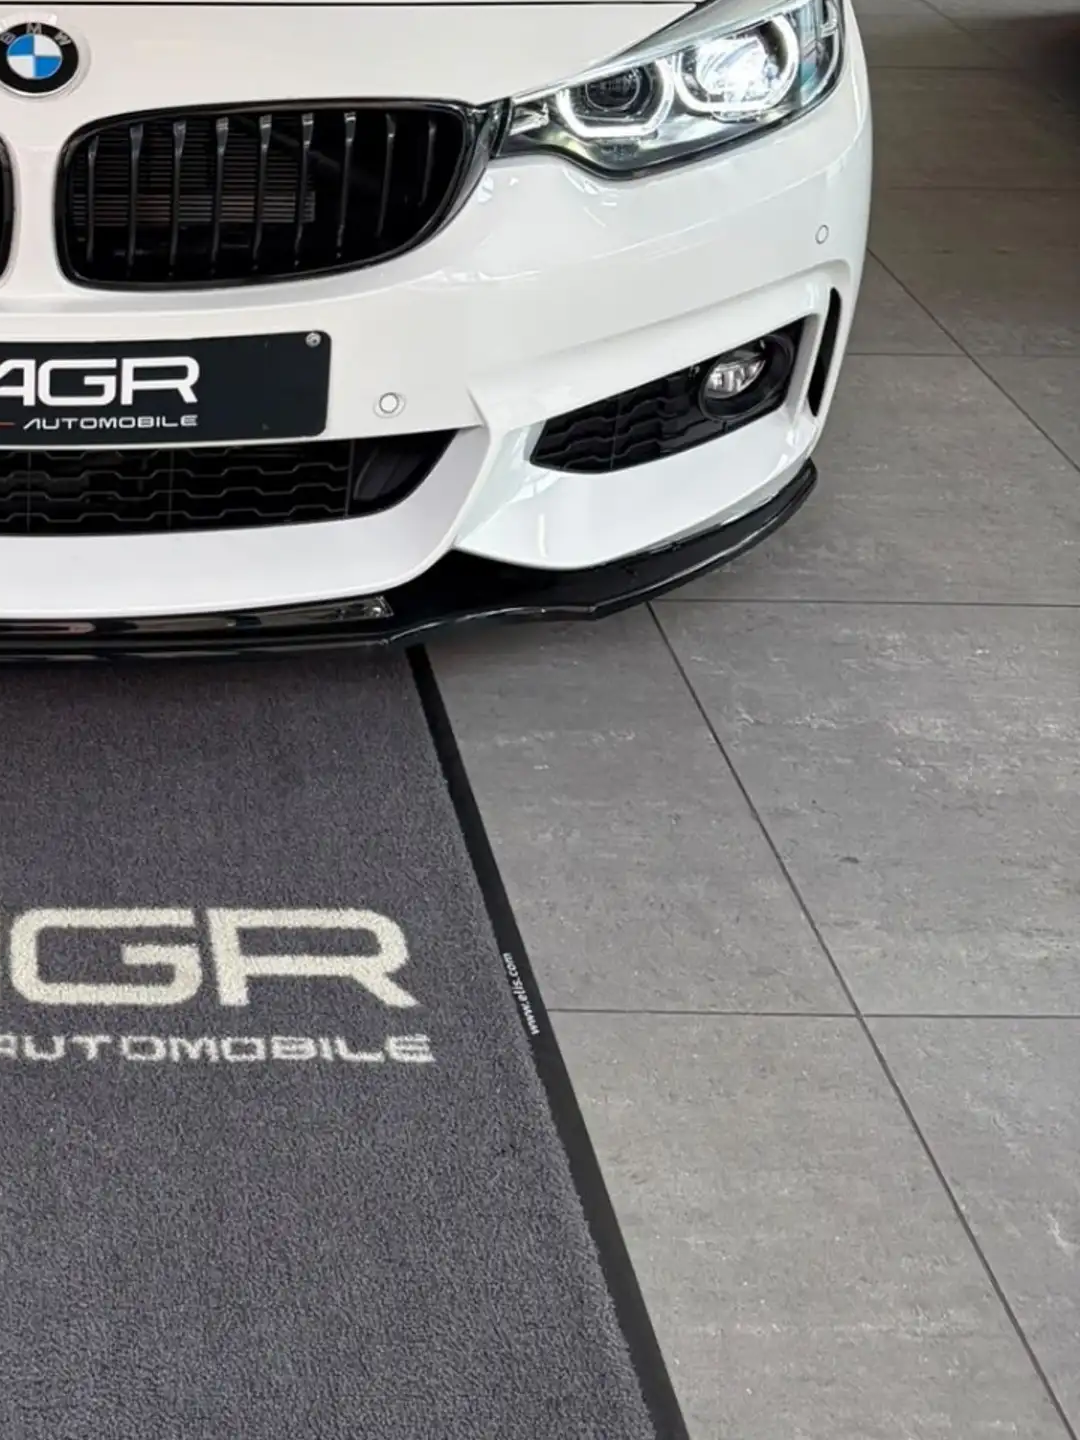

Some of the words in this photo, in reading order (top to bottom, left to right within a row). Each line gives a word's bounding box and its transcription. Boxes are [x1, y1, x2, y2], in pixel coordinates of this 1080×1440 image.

[0, 22, 72, 46] BMW
[23, 414, 198, 431] AUTOMOBILE
[503, 952, 540, 1035] www.elis.com
